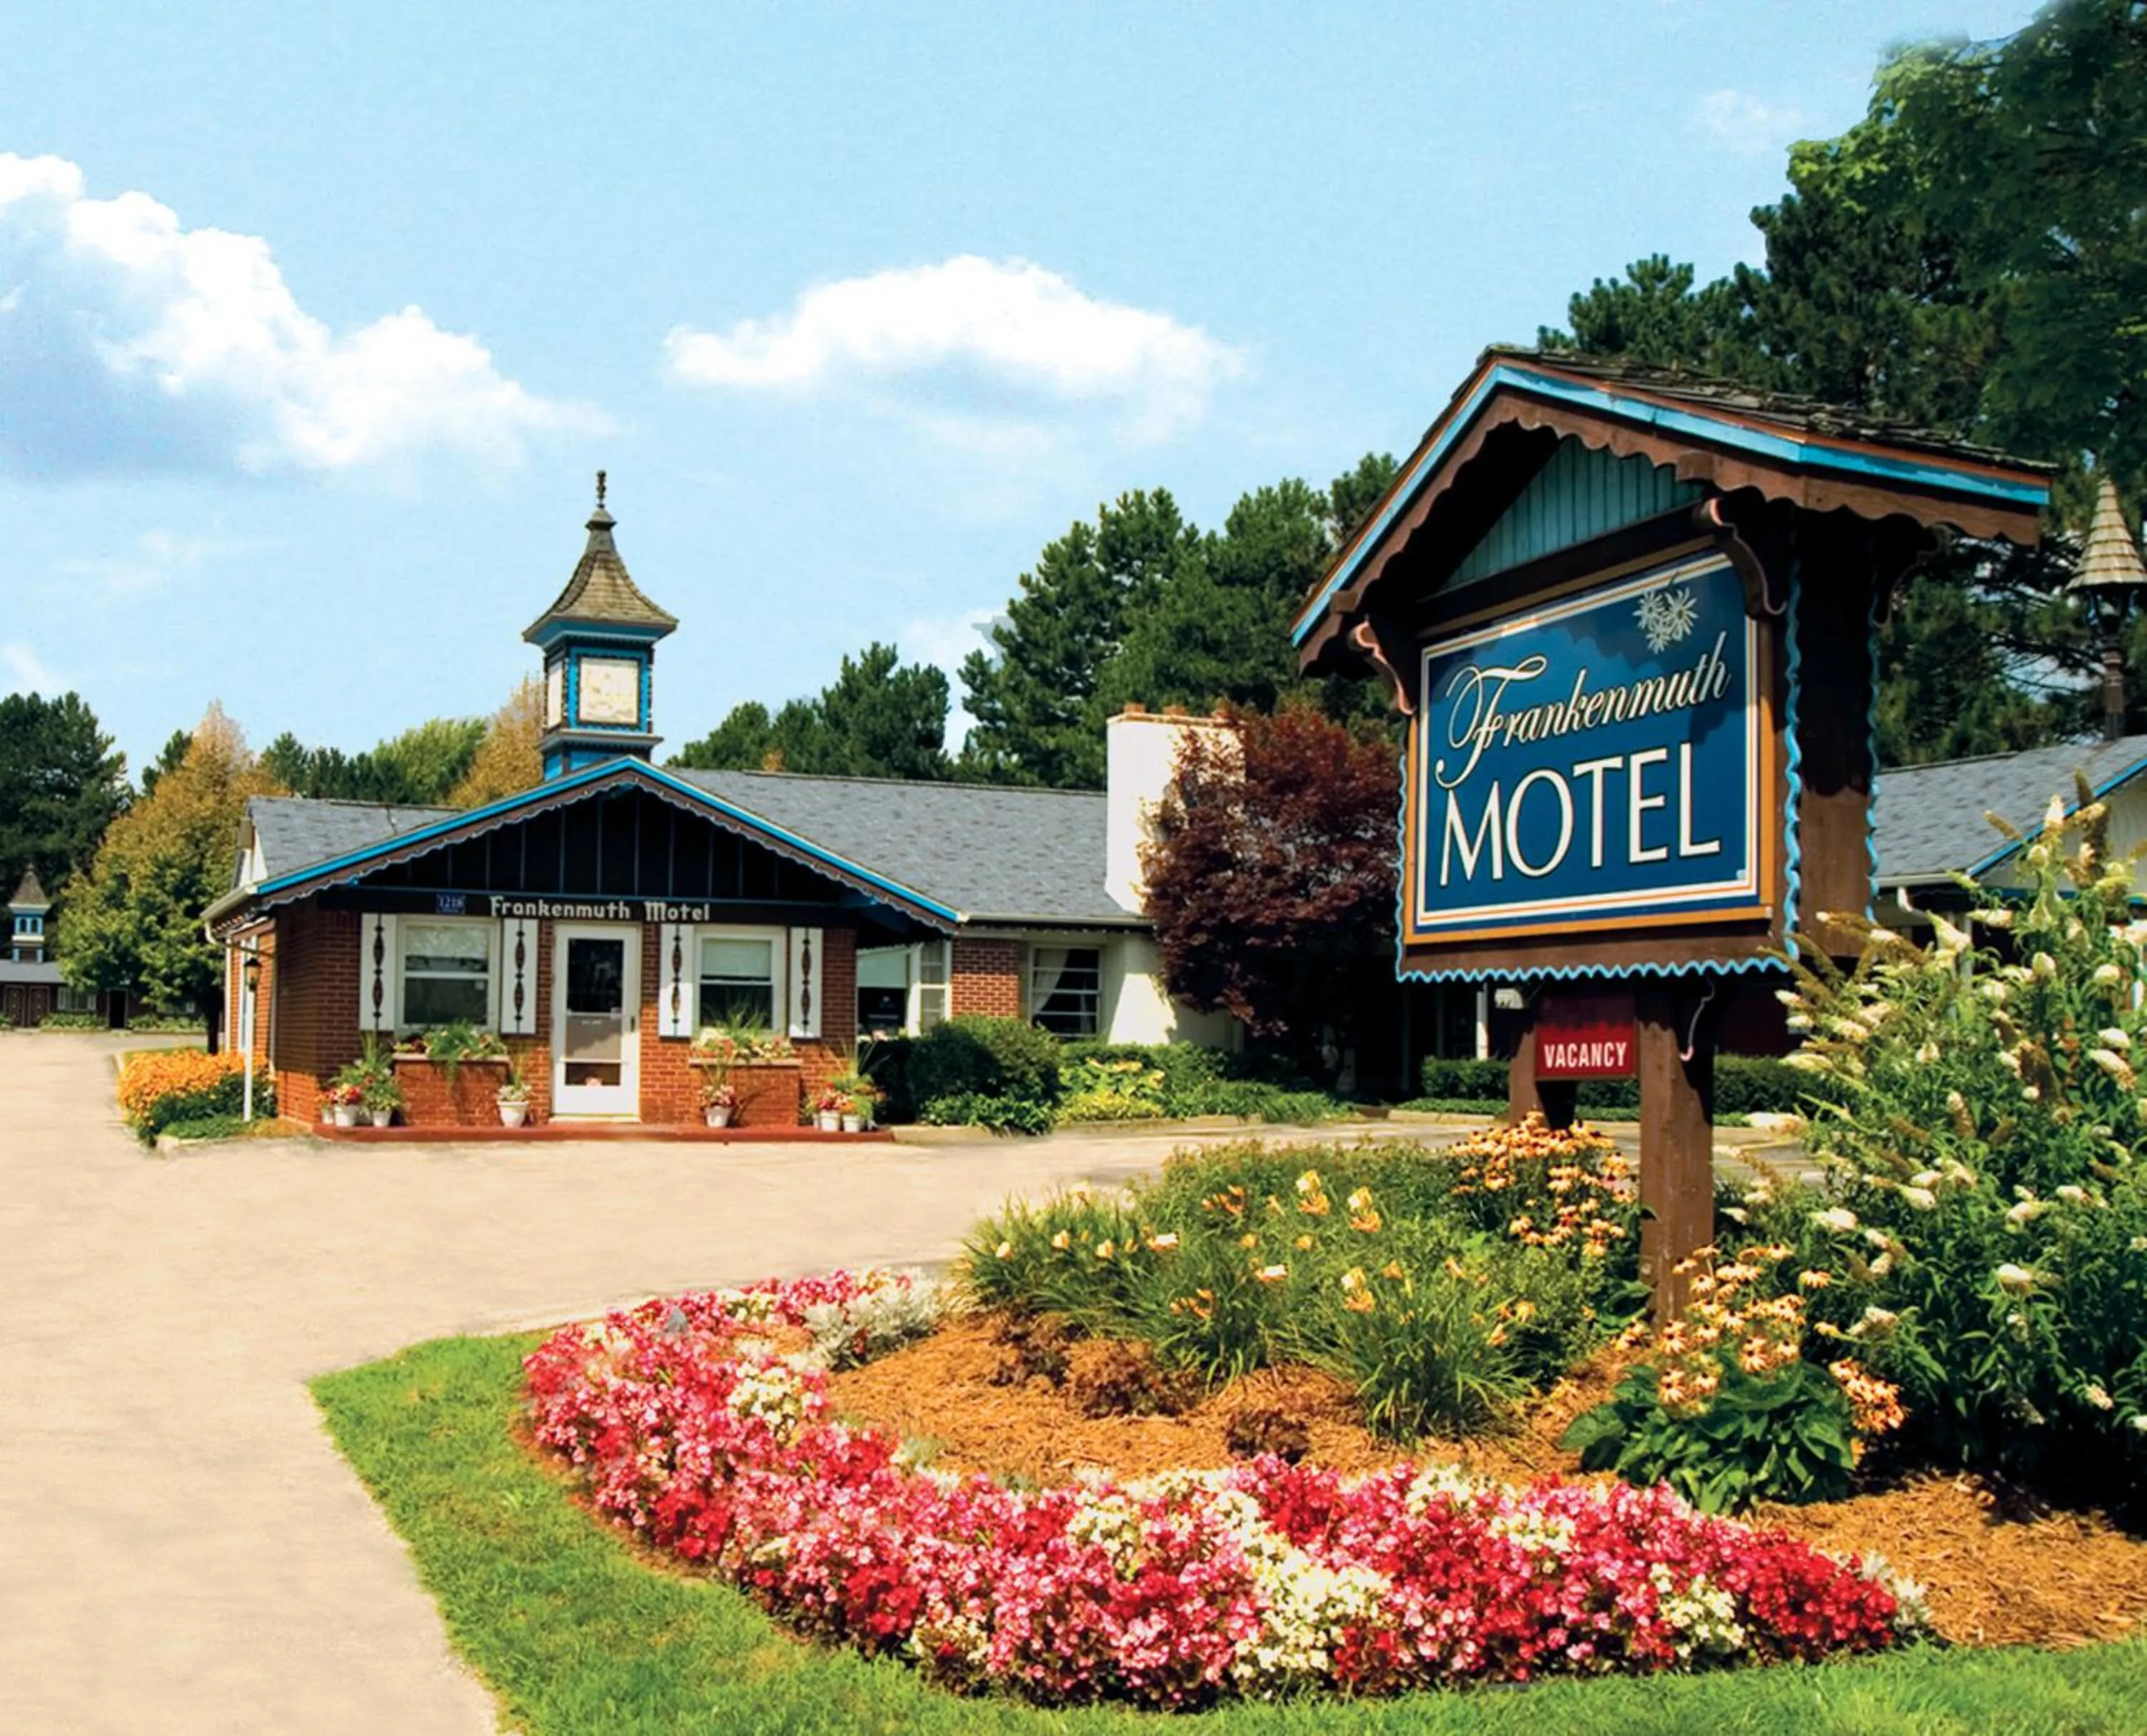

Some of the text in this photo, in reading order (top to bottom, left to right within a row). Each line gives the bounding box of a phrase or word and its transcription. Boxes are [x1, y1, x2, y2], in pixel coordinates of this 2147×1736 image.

[1436, 632, 1731, 788] Frankenmuth
[1440, 743, 1720, 886] MOTEL
[490, 896, 709, 922] Frankenmuth Motel
[1544, 1042, 1627, 1068] VACANCY
